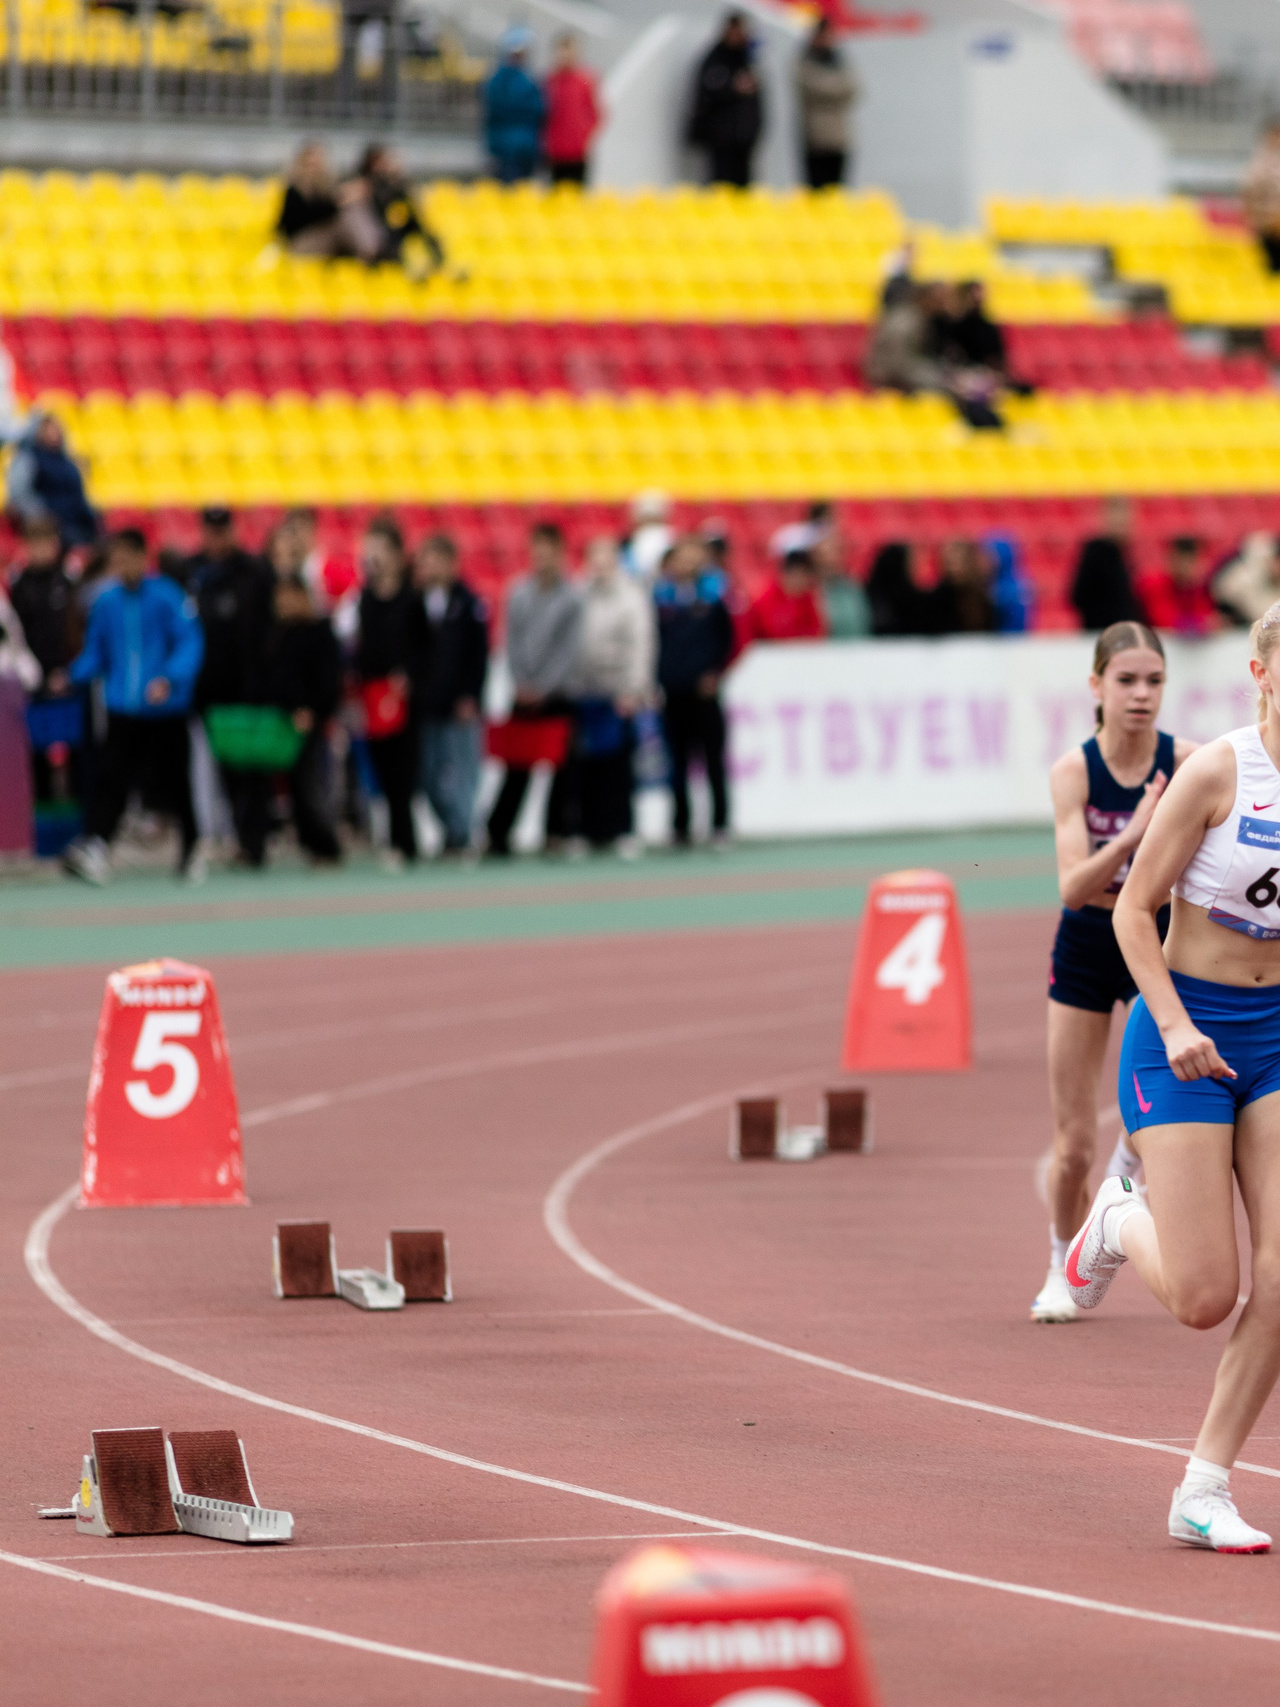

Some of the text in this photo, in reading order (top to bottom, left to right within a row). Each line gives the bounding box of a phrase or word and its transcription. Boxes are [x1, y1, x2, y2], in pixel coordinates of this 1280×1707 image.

[875, 913, 948, 1006] 4
[124, 1010, 202, 1120] 5
[640, 1615, 845, 1677] MONDO
